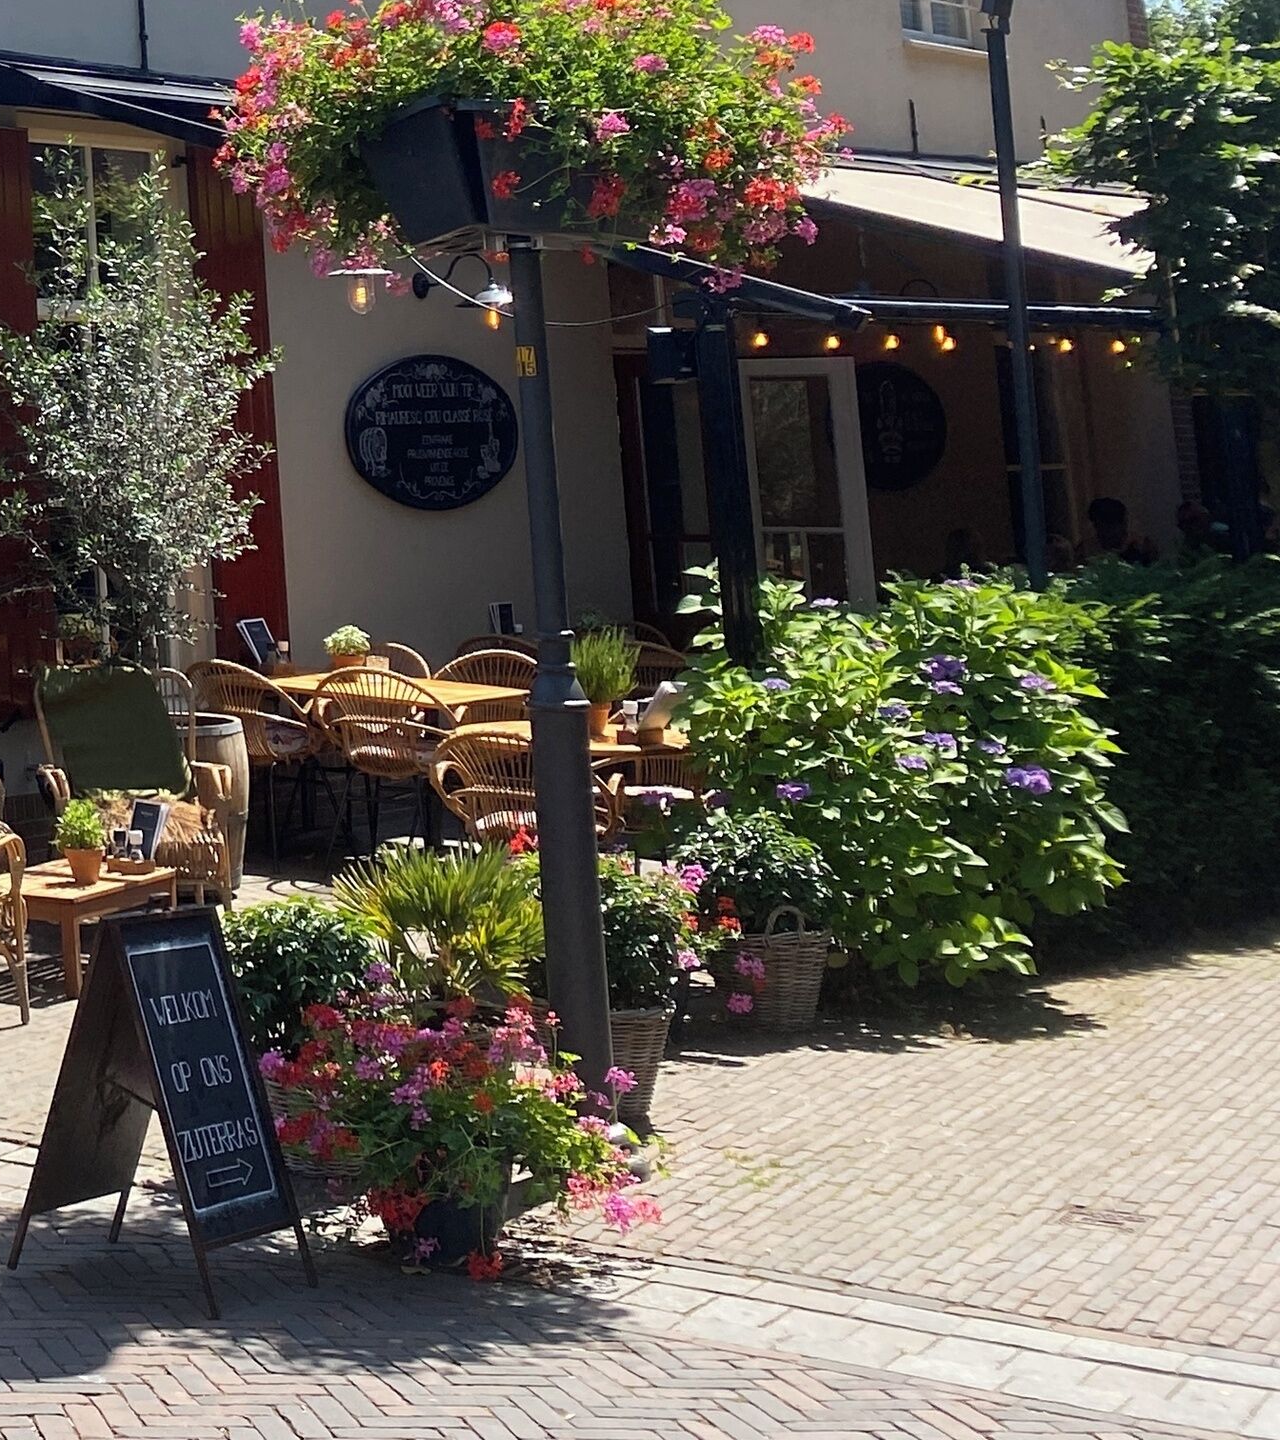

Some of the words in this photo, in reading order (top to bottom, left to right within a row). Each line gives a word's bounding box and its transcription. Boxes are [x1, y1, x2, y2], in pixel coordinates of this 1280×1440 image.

[148, 989, 218, 1026] WELKOM
[172, 1062, 192, 1093] OP
[201, 1055, 233, 1087] ONS
[178, 1117, 259, 1164] ZIJTERRAS
